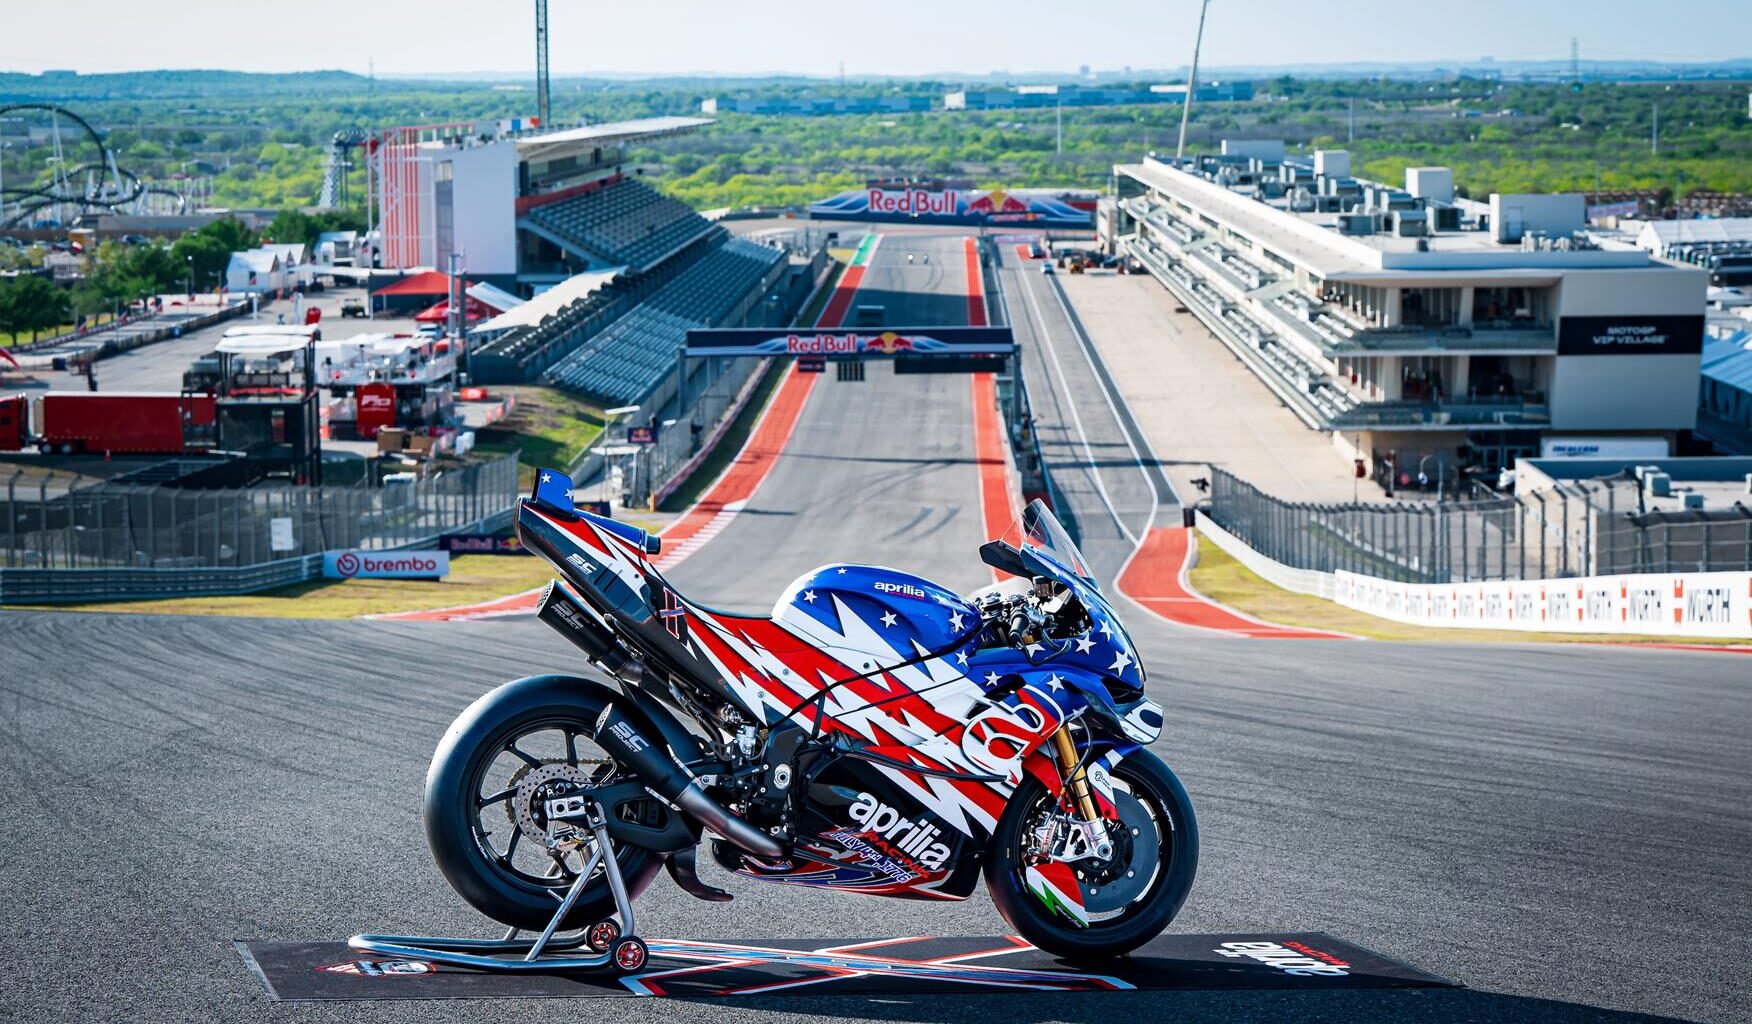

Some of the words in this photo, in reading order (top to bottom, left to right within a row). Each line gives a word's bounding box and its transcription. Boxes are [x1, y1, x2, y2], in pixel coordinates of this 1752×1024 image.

[869, 190, 912, 213] Red
[914, 190, 957, 214] Bull
[787, 334, 821, 353] Red
[823, 333, 858, 353] Bull
[1593, 335, 1616, 344] VIP
[364, 557, 437, 572] brembo
[567, 553, 598, 574] SC
[874, 581, 925, 598] aprilia
[555, 600, 591, 629] SC
[609, 726, 640, 753] PROJECT
[613, 721, 650, 751] SC
[848, 791, 951, 871] aprilia
[880, 860, 913, 884] 1776
[1213, 941, 1351, 976] aprilia
